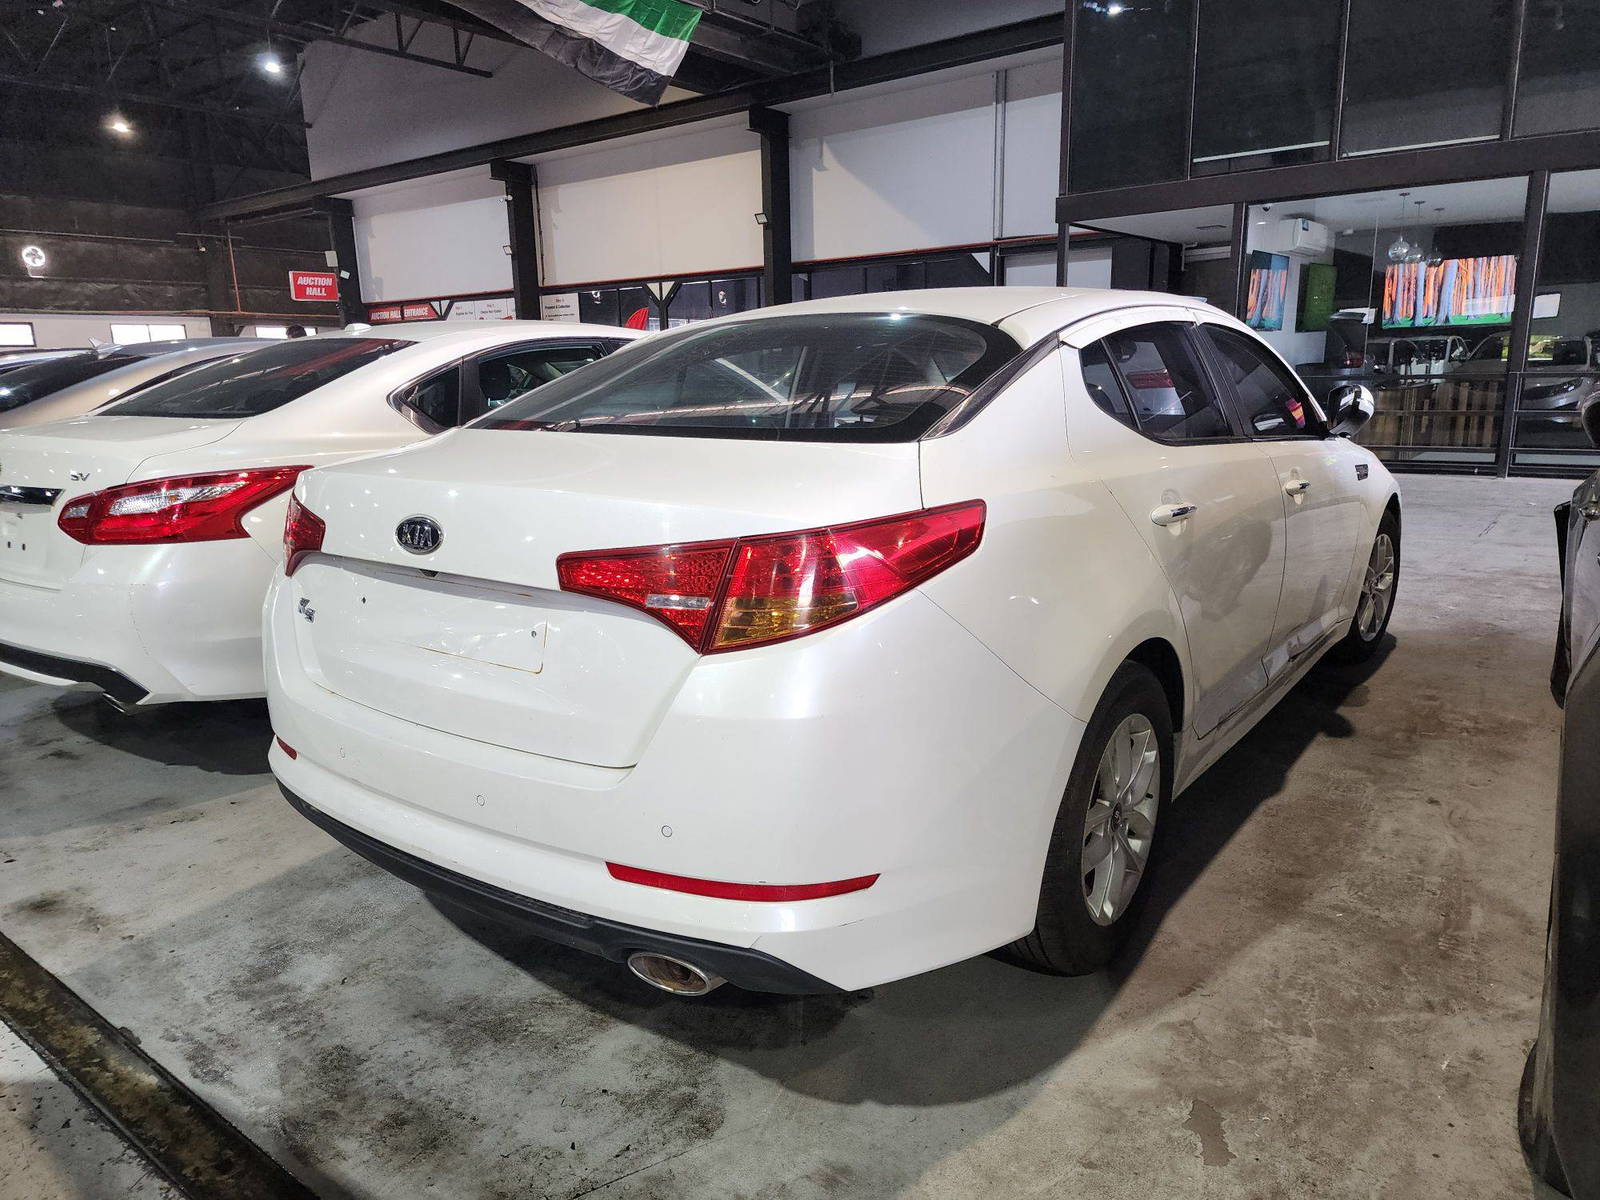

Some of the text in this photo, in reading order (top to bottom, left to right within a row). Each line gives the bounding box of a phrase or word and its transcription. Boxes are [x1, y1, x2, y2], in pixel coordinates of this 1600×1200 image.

[297, 276, 333, 287] AUCTION
[305, 287, 327, 296] HALL
[404, 307, 429, 318] ENTRANCE
[402, 523, 433, 547] KIA
